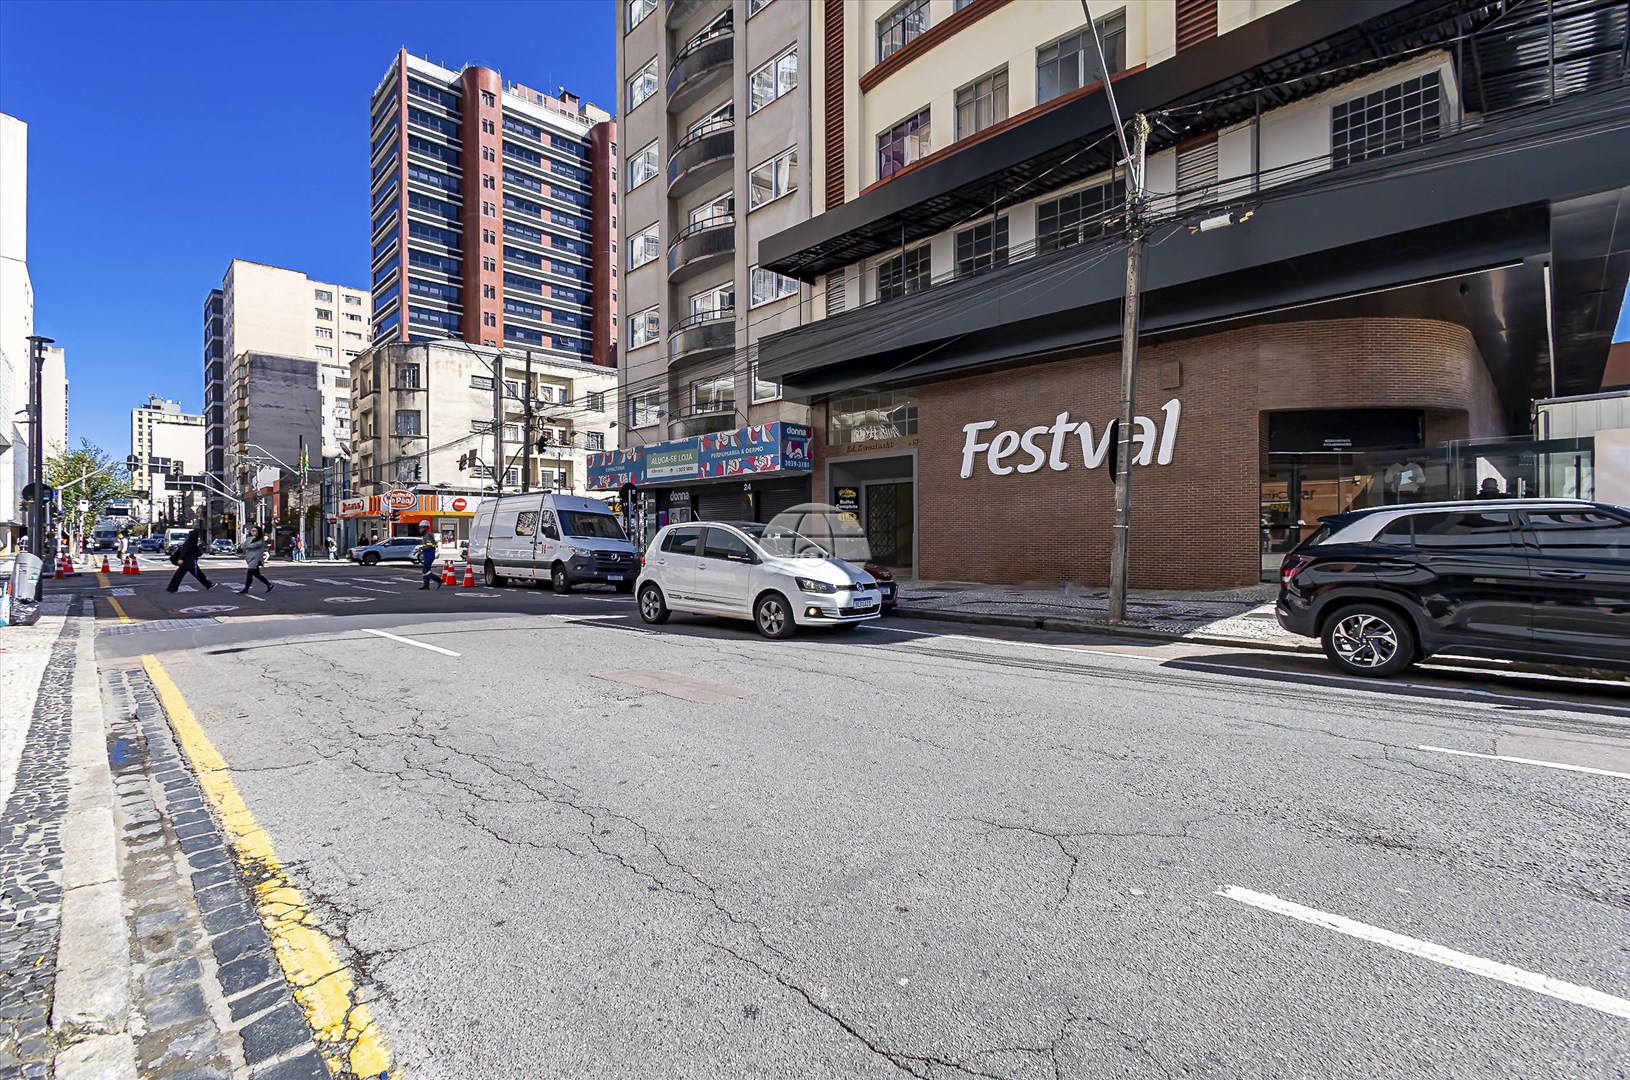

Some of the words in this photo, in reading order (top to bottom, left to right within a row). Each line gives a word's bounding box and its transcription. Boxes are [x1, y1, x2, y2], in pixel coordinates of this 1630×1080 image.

[786, 426, 807, 436] donna
[960, 398, 1181, 479] Festval
[710, 449, 741, 459] PERFUMARIA
[745, 446, 764, 455] DERMO
[650, 455, 678, 465] ALUGA-SE
[678, 453, 693, 462] LOJA
[743, 483, 752, 491] 24
[669, 490, 690, 502] donna
